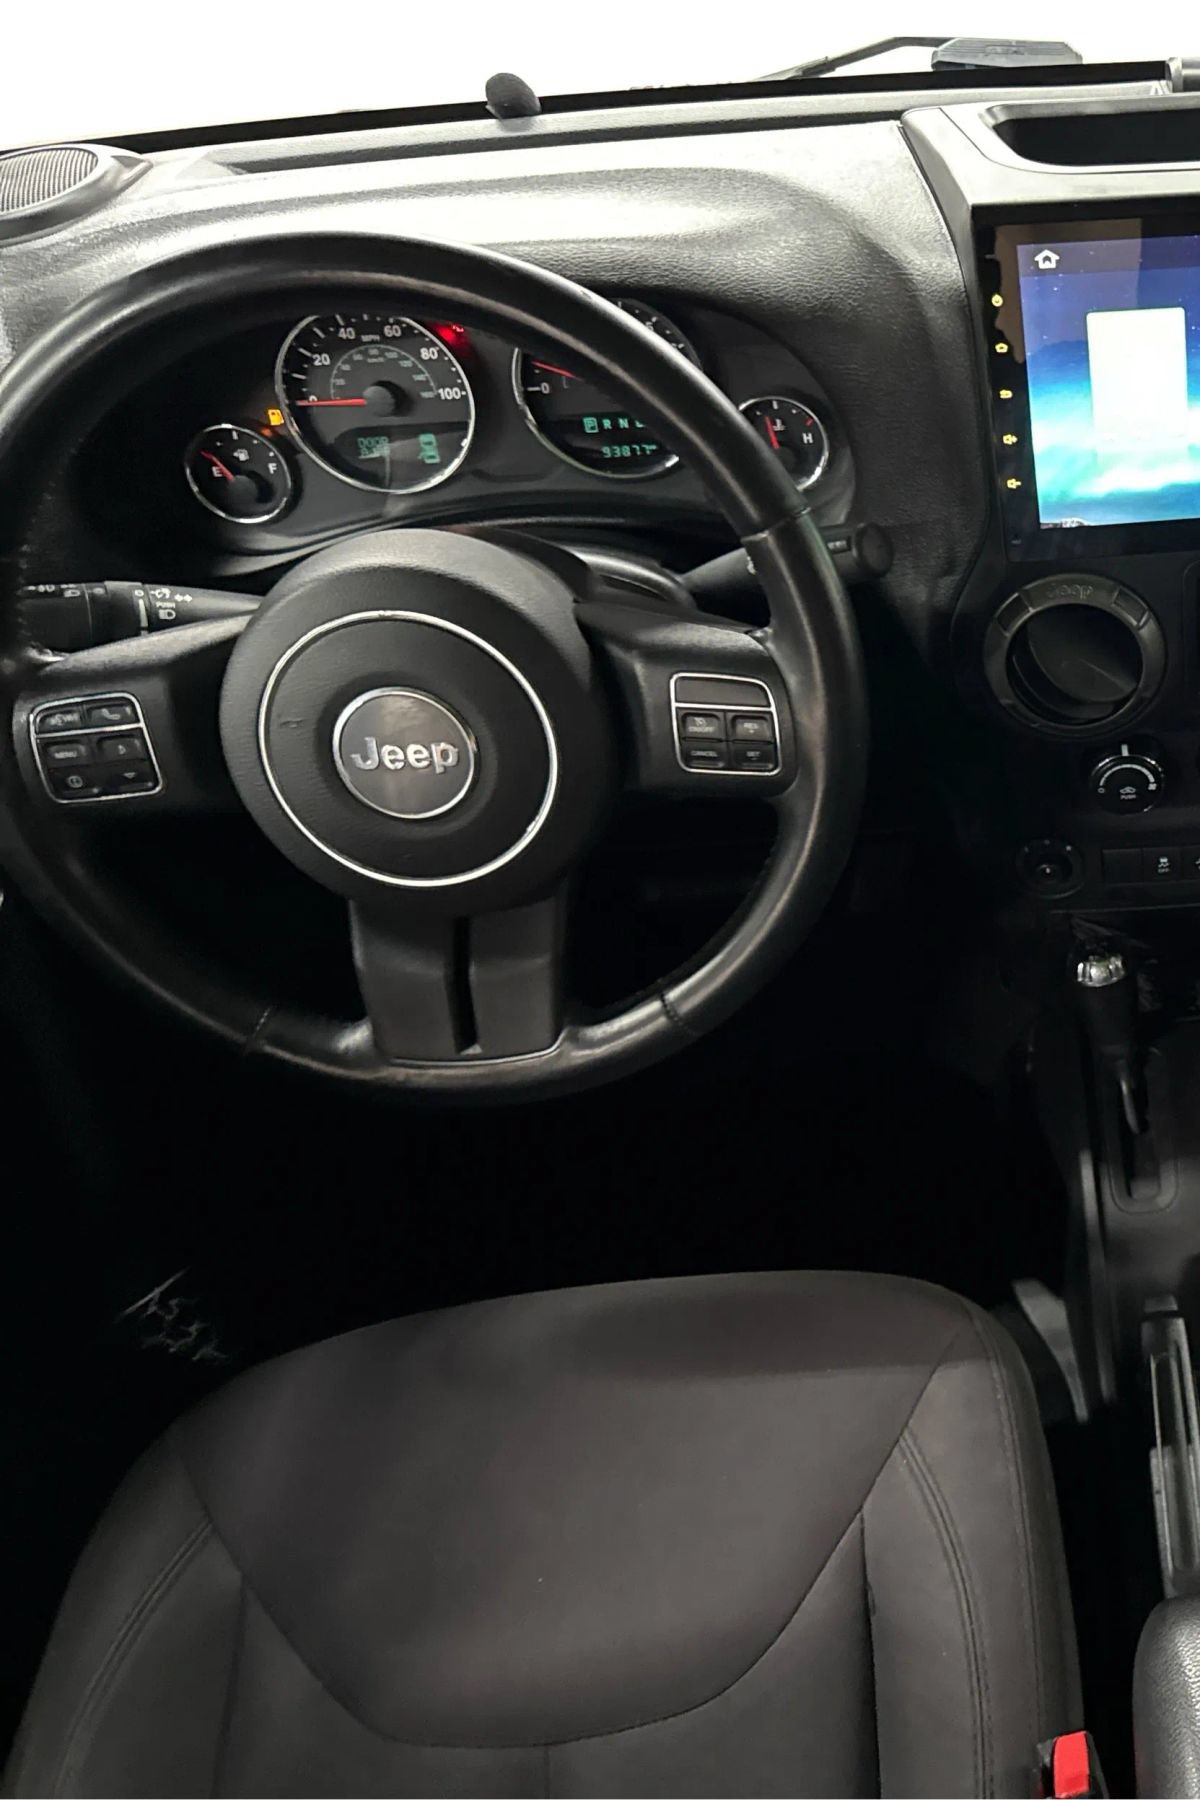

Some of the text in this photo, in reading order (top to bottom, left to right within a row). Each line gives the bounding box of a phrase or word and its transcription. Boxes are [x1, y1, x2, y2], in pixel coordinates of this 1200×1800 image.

[338, 327, 355, 340] 40
[384, 325, 401, 337] 60
[312, 353, 330, 366] 20
[420, 348, 438, 360] 80
[438, 388, 461, 400] 100
[540, 382, 550, 394] 0
[602, 419, 612, 430] R
[618, 418, 629, 429] N
[802, 433, 813, 444] H
[601, 444, 651, 458] 93877
[212, 466, 224, 478] E
[268, 463, 277, 474] F
[349, 736, 459, 774] Jeep
